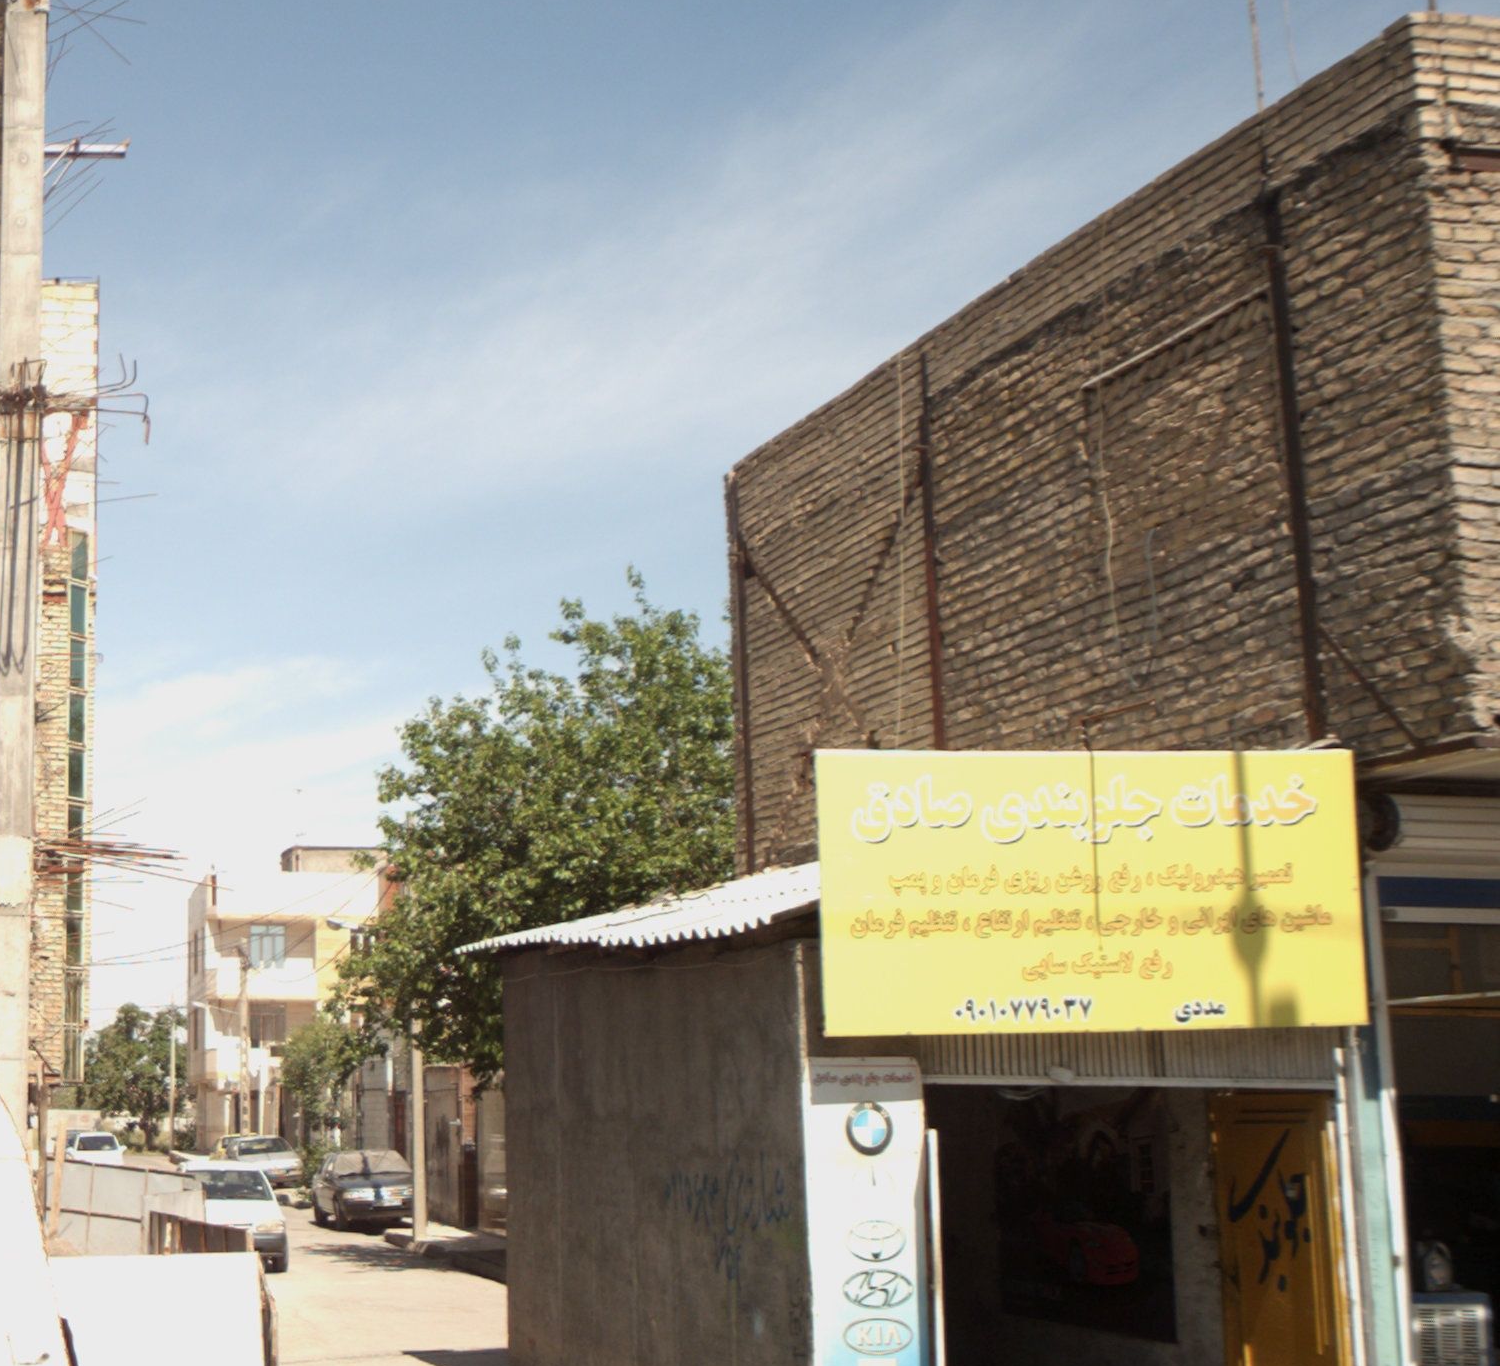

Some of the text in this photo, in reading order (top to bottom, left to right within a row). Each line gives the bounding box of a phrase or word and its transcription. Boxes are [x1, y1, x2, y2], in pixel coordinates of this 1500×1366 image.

[851, 772, 1318, 845] خدمات جلوبندی صادق
[888, 871, 928, 897] پمپ
[930, 873, 942, 895] و
[946, 864, 999, 895] فرمان
[1003, 869, 1051, 894] ریزی
[1055, 865, 1104, 894] روغن
[1107, 862, 1142, 894] رفع
[1157, 862, 1246, 892] هیدرولیک
[850, 908, 906, 939] فرمان
[907, 909, 959, 939] تنظیم
[974, 908, 1030, 939] ارتفاع
[1032, 908, 1083, 938] تنظیم
[1099, 906, 1164, 937] خارجی
[1167, 914, 1180, 936] و
[1182, 905, 1238, 935] ایرانی
[1279, 903, 1333, 933] ماشین
[1021, 948, 1174, 982] رفع لاستیک سایی
[954, 996, 1093, 1022] ۰۹۰۱۰۷۷۹۰۳۷
[856, 1322, 903, 1347] KIA
